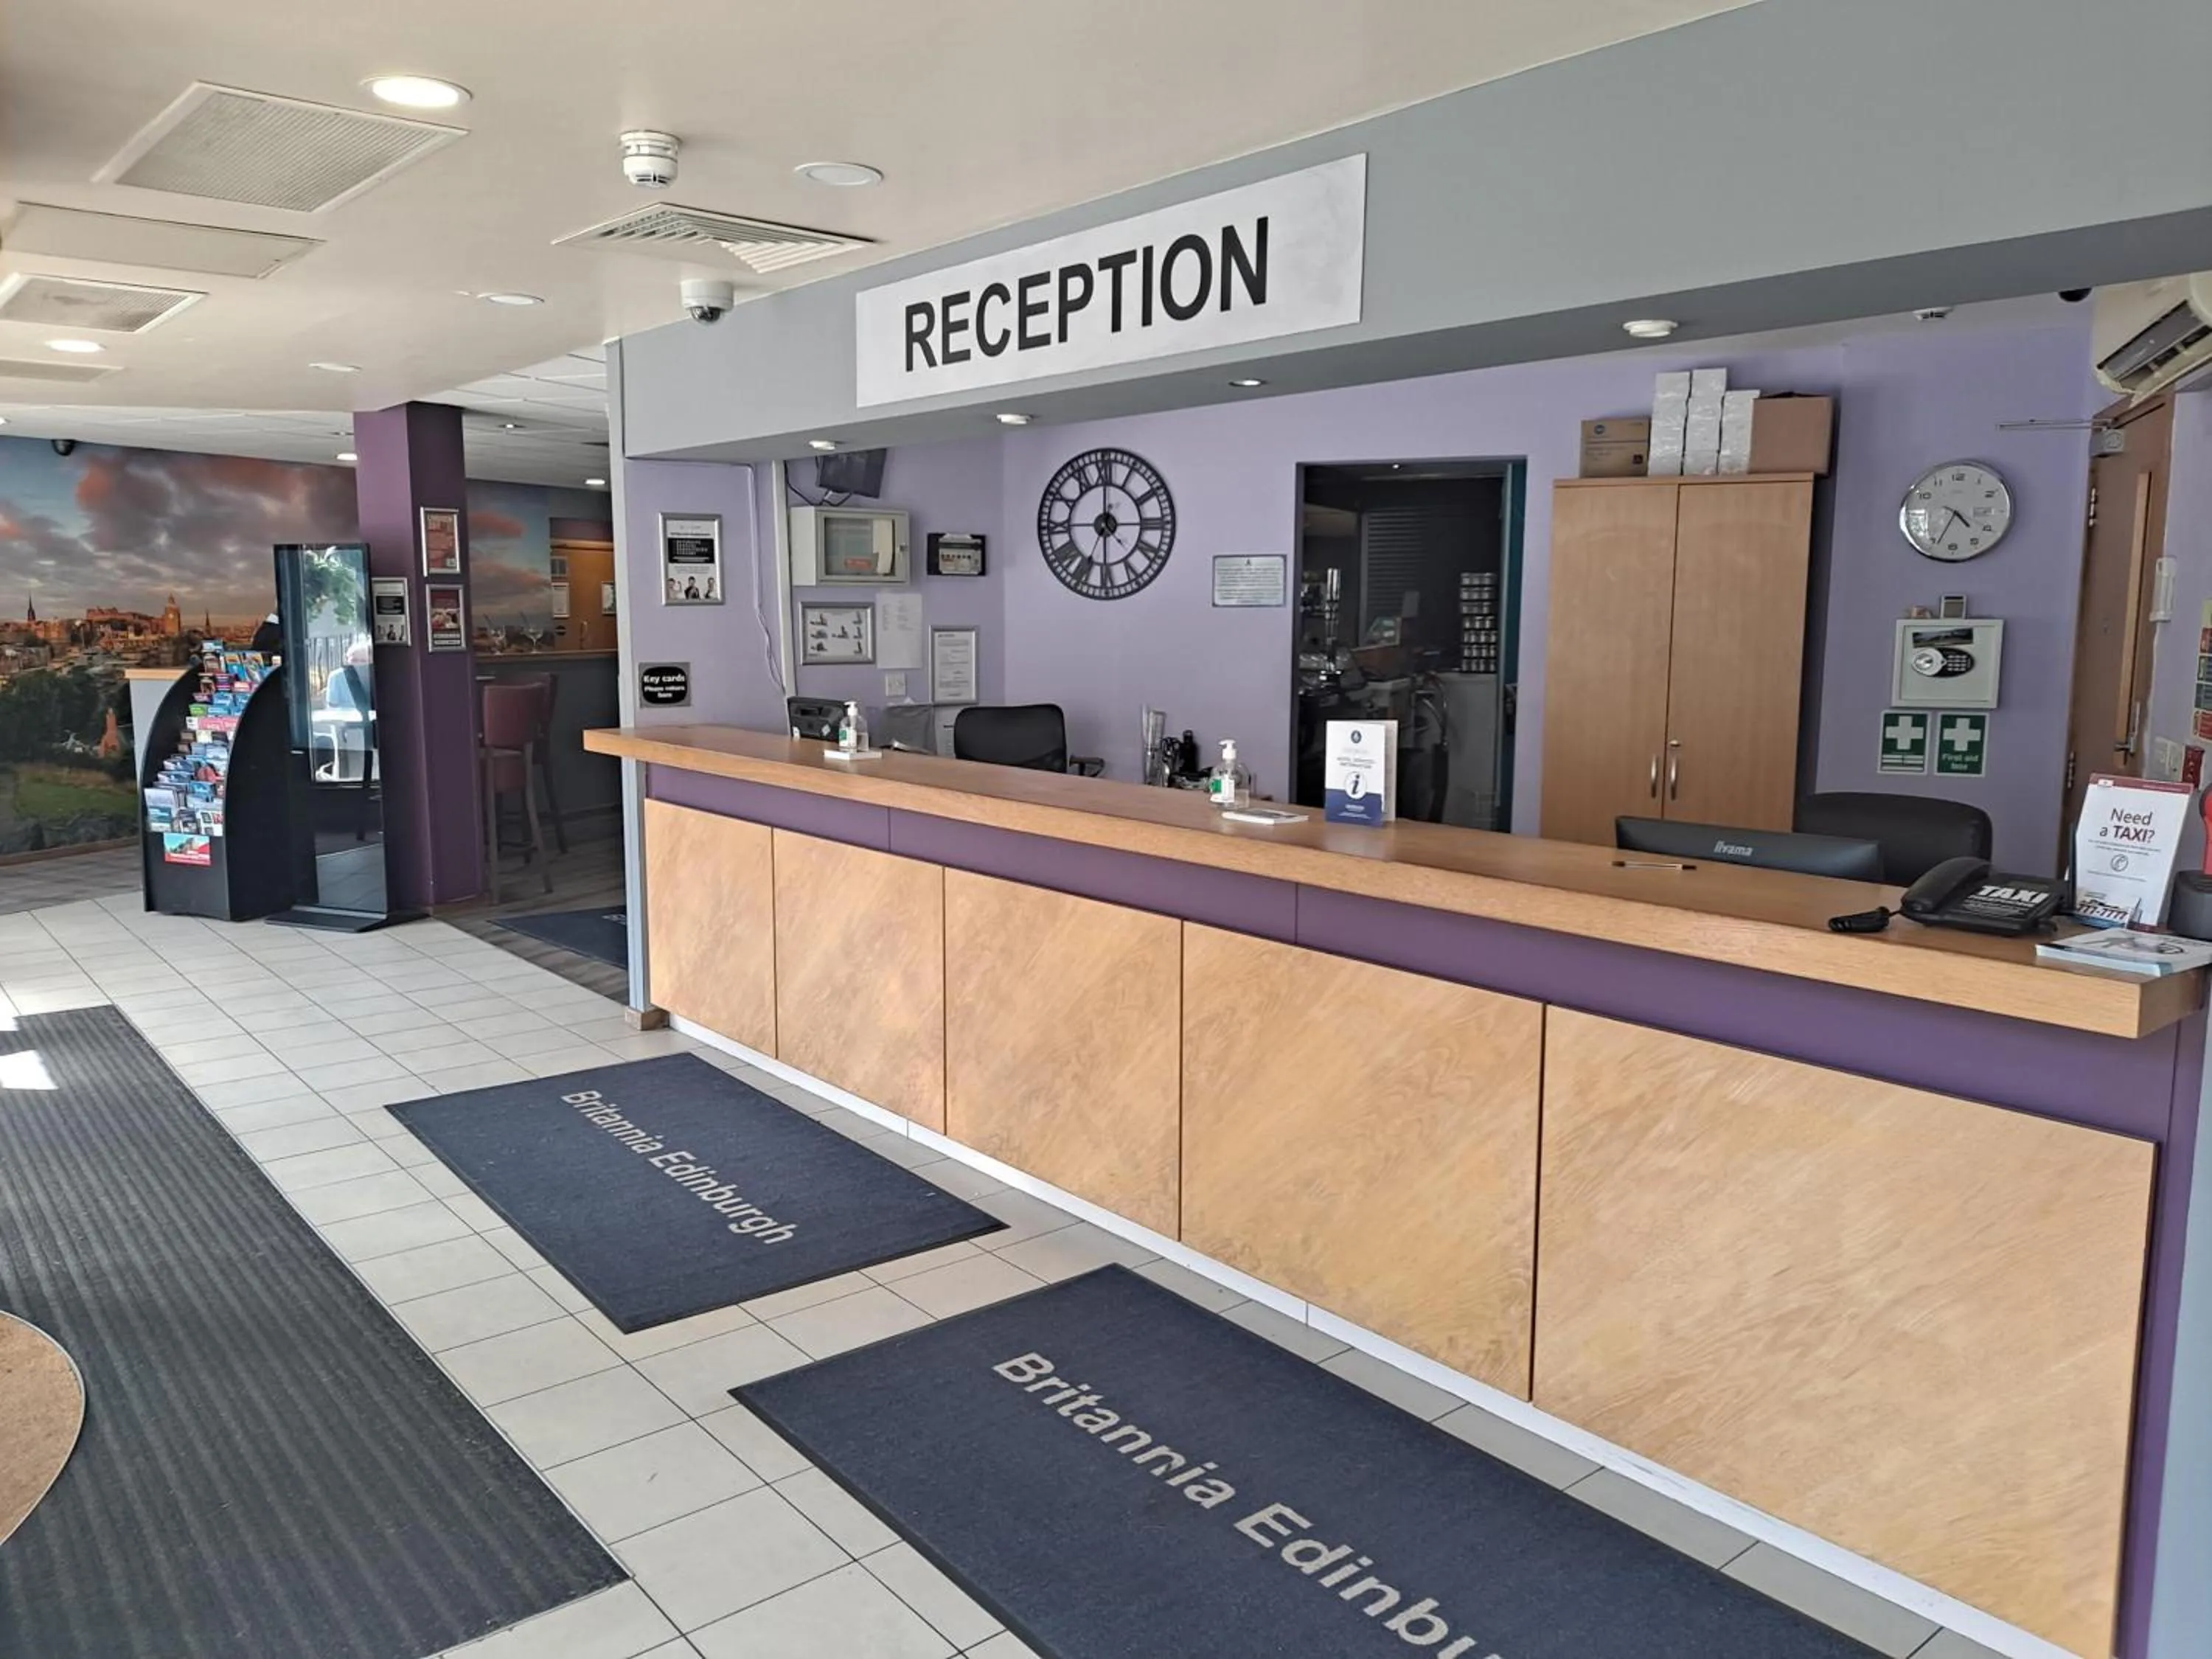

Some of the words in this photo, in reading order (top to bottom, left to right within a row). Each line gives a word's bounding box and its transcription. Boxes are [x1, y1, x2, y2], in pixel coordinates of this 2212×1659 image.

[905, 215, 1269, 372] RECEPTION
[644, 675, 660, 685] Key
[662, 673, 685, 682] cards
[2110, 808, 2153, 826] Need
[2099, 826, 2108, 837] a
[2113, 824, 2155, 844] TAXI?
[1978, 885, 2050, 905] TAXI
[561, 1091, 664, 1154] Britannia
[649, 1151, 799, 1245] Edinburgh
[992, 1352, 1236, 1509] Britannia
